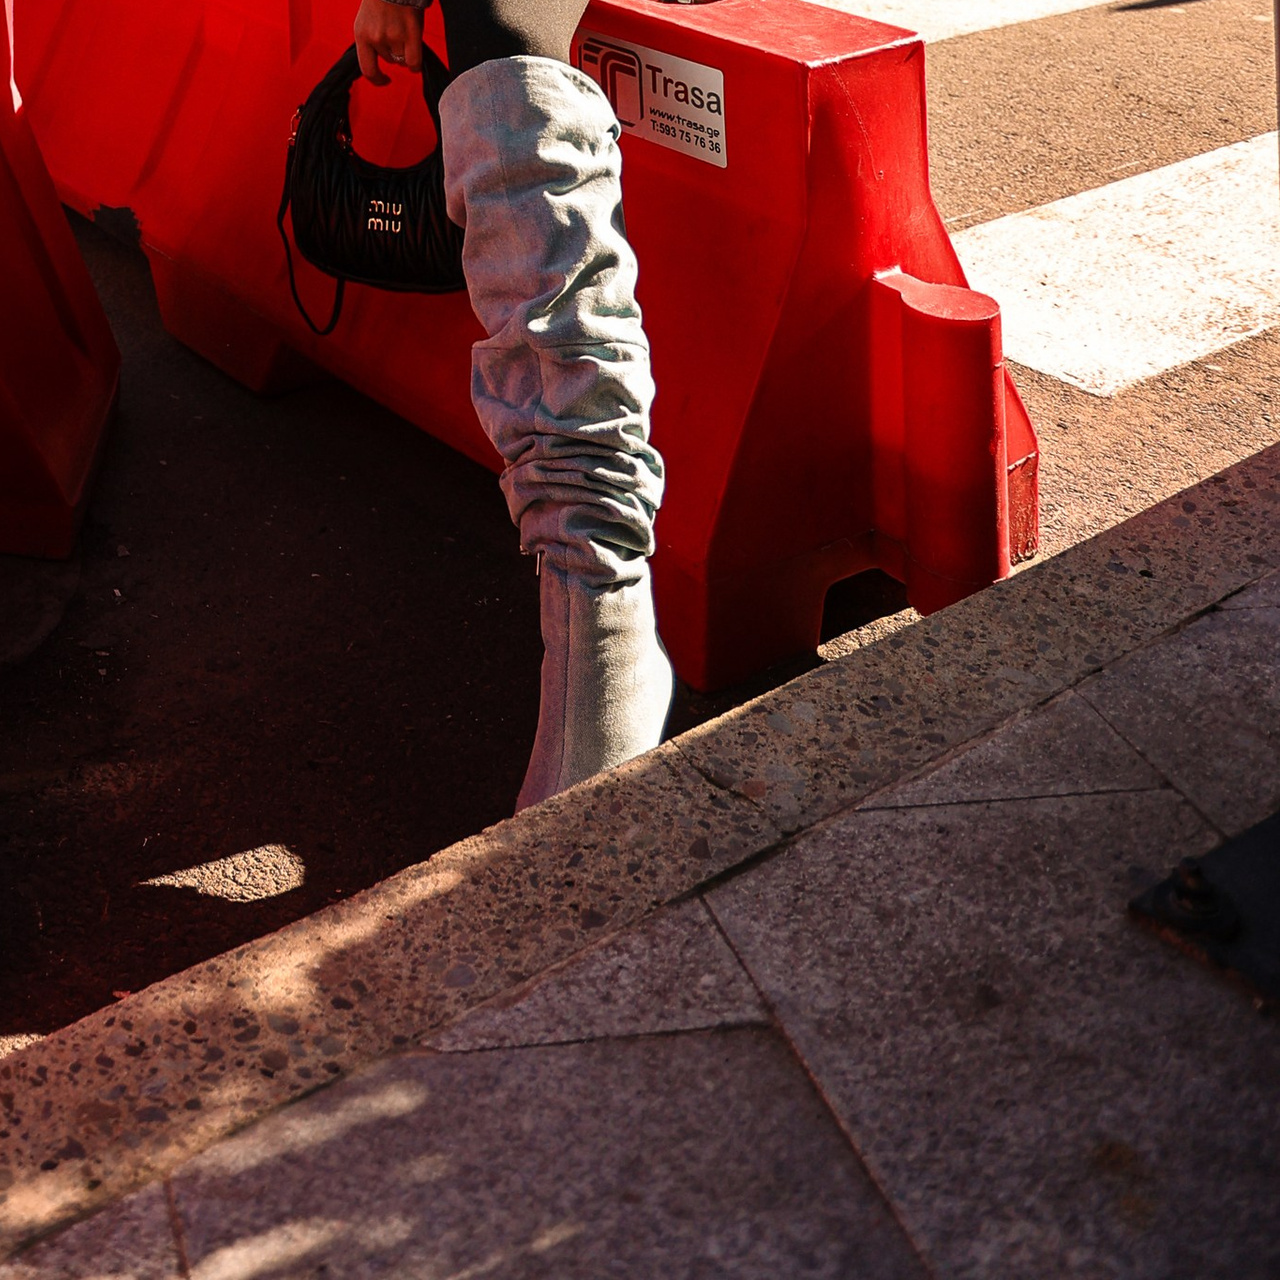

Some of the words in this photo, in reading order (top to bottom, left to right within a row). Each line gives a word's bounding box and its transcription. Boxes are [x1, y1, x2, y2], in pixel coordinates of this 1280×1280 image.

[645, 63, 722, 116] Trasa
[649, 106, 720, 138] www.trasa.ge
[650, 119, 677, 138] T:593
[679, 129, 691, 143] 75
[693, 134, 706, 149] 76
[708, 139, 721, 154] 36
